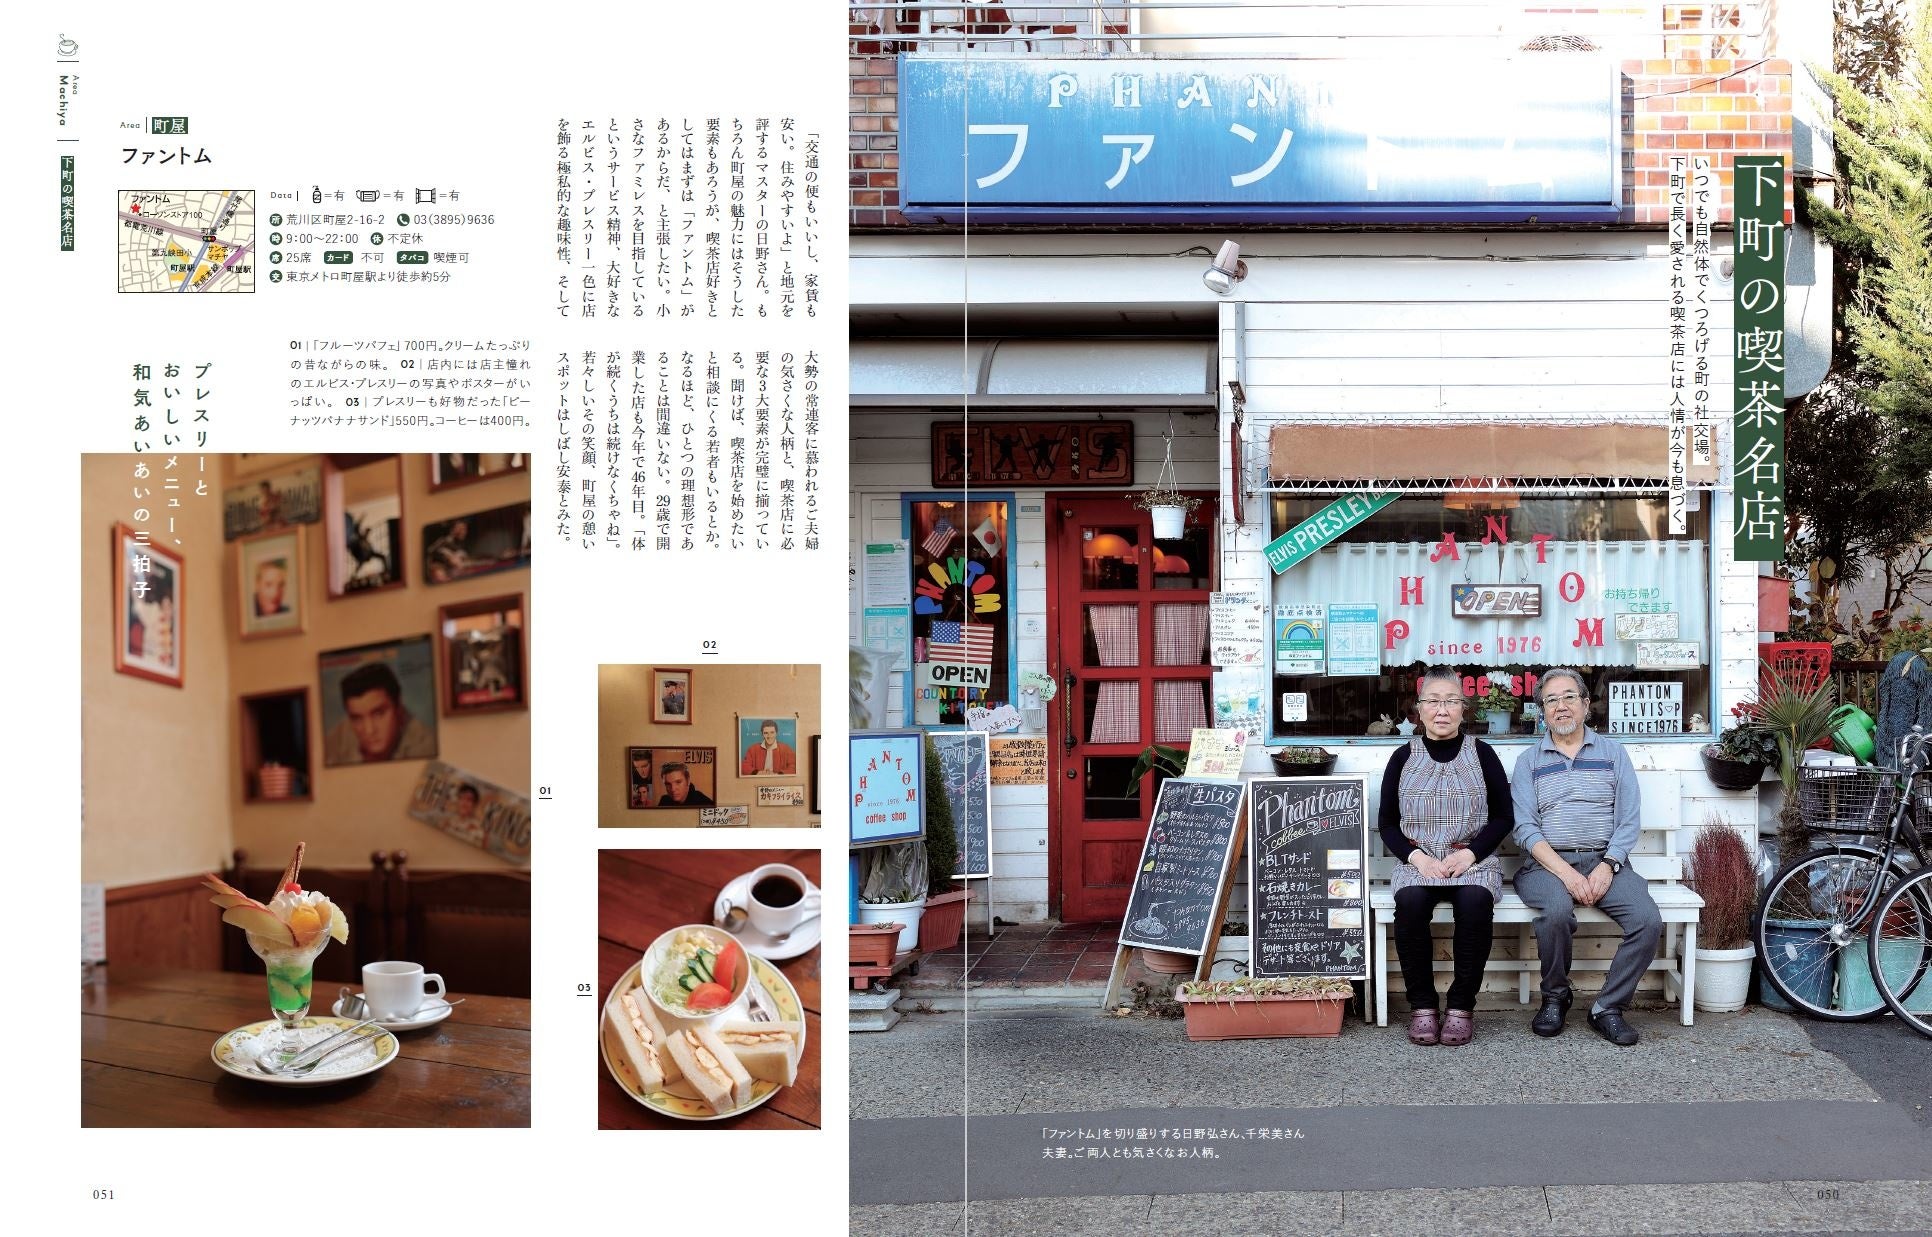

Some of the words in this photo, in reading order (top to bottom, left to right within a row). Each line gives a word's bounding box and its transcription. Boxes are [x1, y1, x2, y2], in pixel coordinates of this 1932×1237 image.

[1268, 540, 1298, 566] ELVIS
[1293, 491, 1374, 552] PRESLEY
[1384, 515, 1605, 651] PHANTOM
[1460, 591, 1529, 611] OPEN
[1605, 588, 1660, 600] お持ち帰り
[1628, 602, 1672, 613] できます
[1427, 640, 1483, 655] since
[1497, 636, 1542, 654] 1976
[931, 665, 988, 684] OPEN
[1613, 685, 1670, 699] PHANTOM
[1624, 702, 1663, 717] ELVIS
[685, 751, 712, 764] ELVIS
[855, 750, 916, 807] PHANTOM
[1193, 787, 1235, 804] 生パスタ
[866, 813, 886, 824] coffee
[892, 811, 907, 822] shop
[1258, 788, 1360, 835] Phantom
[1271, 828, 1306, 848] coffee
[1329, 814, 1353, 829] ELVIS
[1266, 852, 1311, 868] BLTサンド
[1267, 881, 1322, 894] 石焼きカレー
[1268, 909, 1324, 921] フレンチトースト
